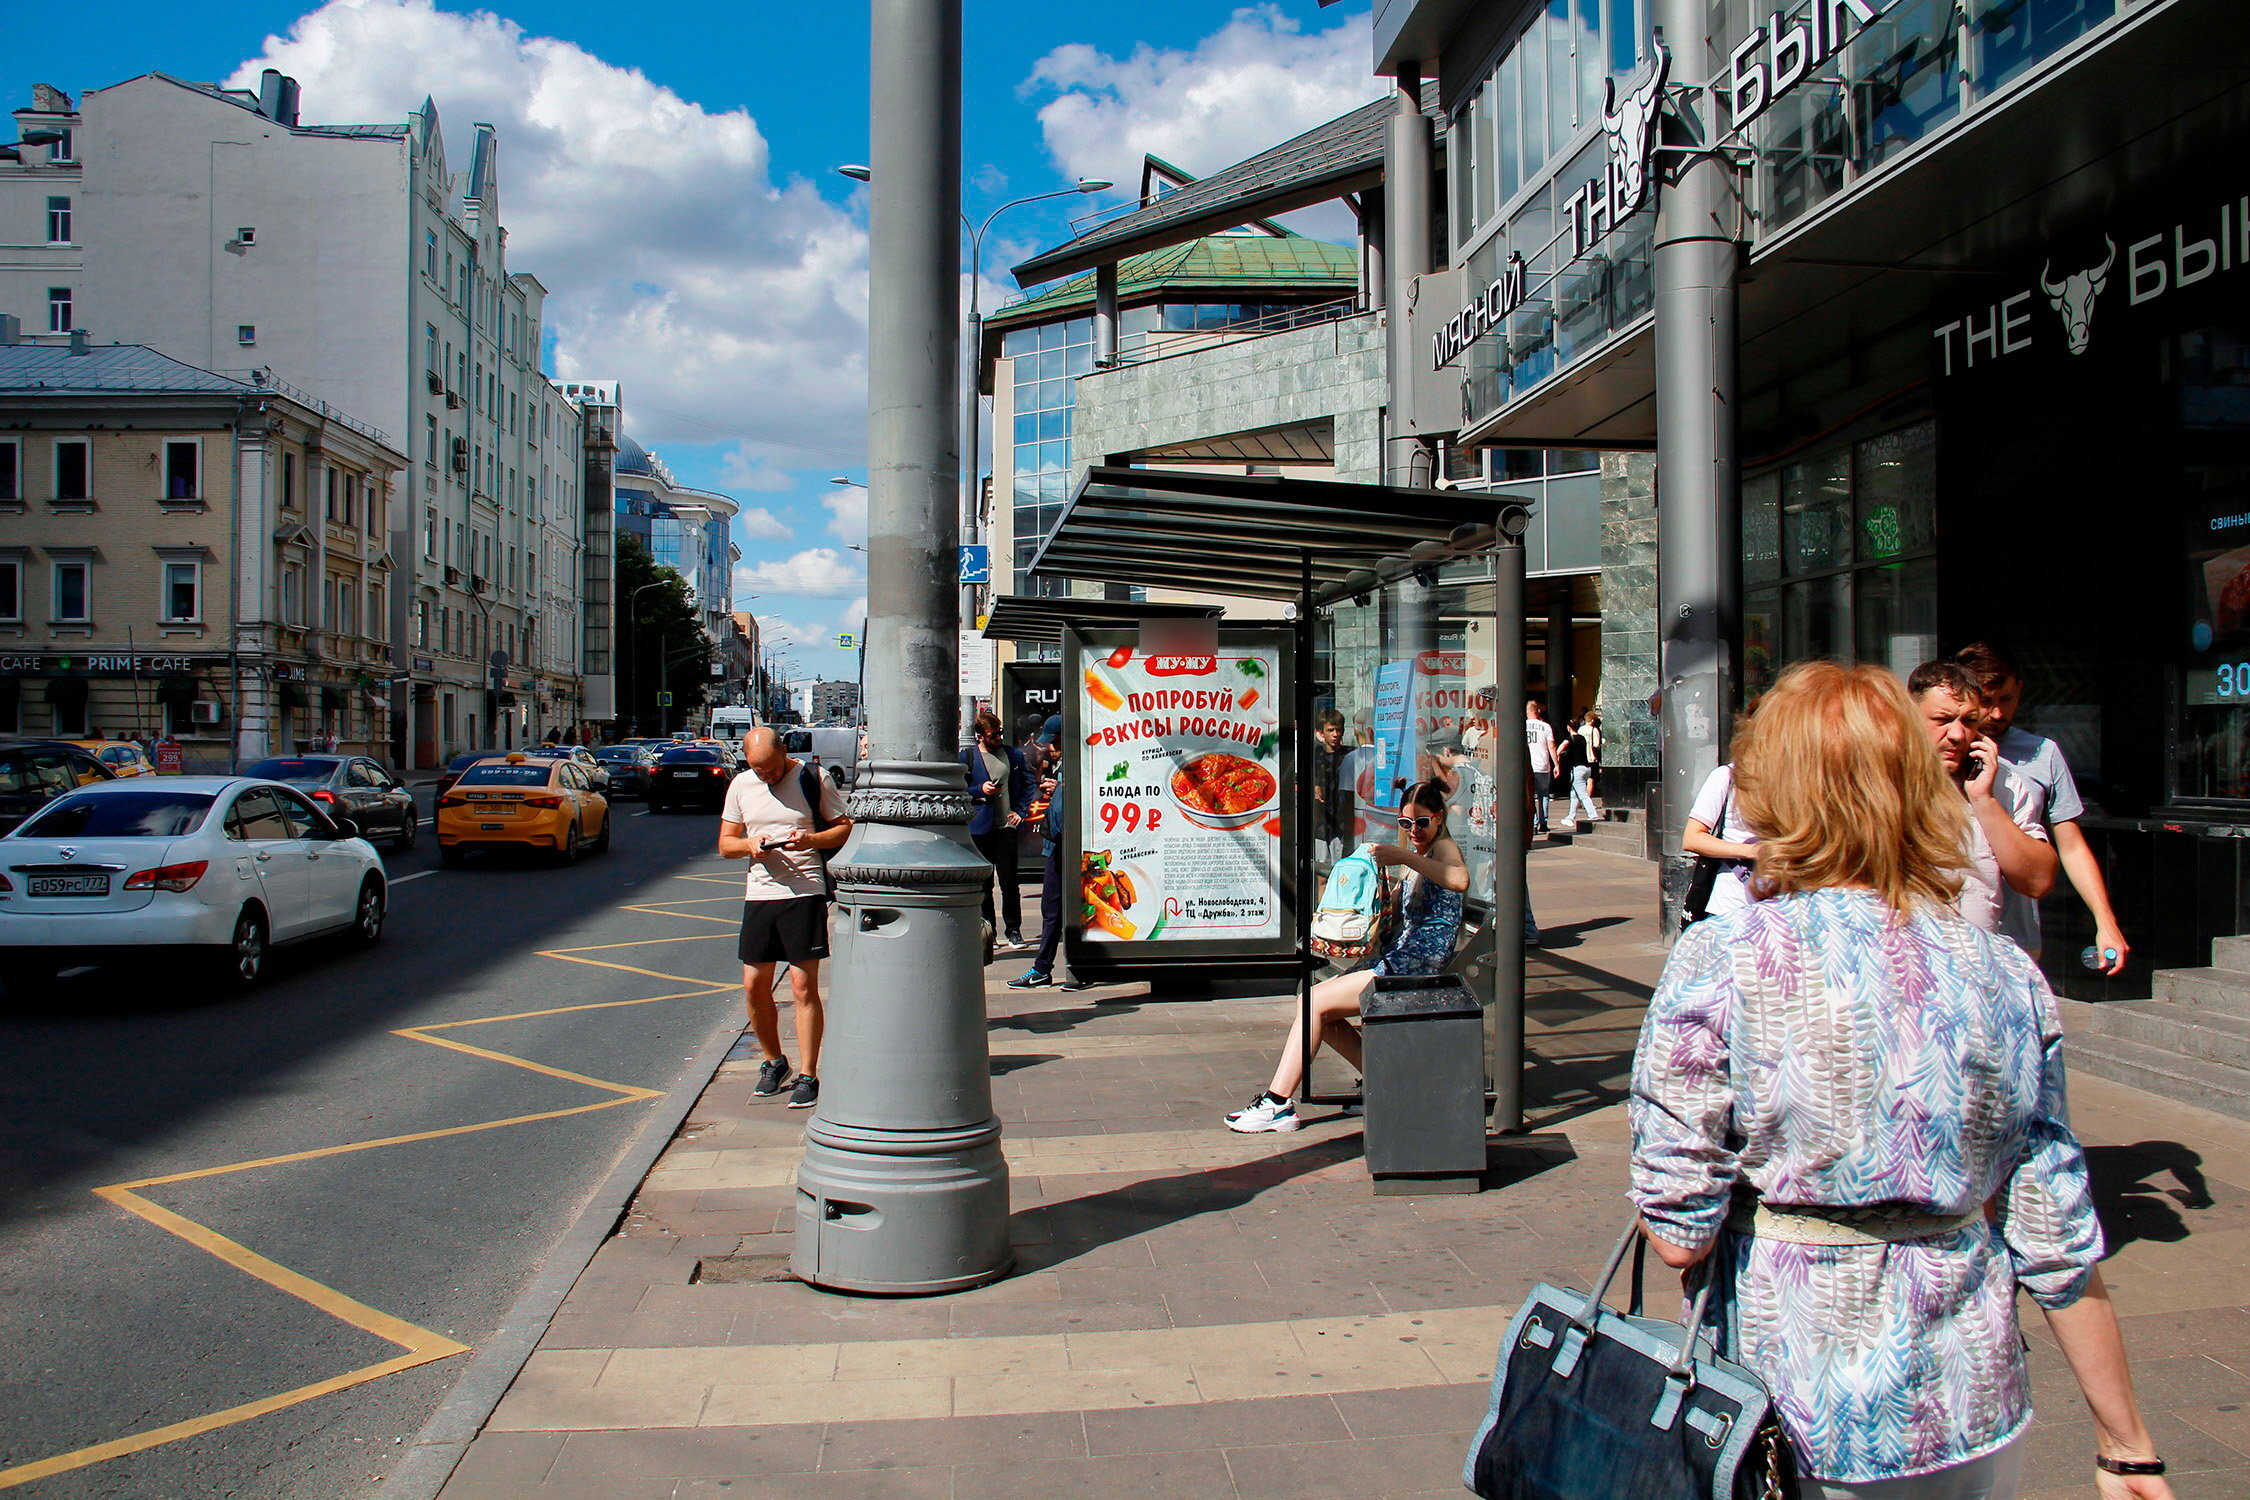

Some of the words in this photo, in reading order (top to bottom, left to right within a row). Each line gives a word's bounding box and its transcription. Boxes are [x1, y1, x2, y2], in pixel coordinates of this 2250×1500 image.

[1432, 251, 1526, 371] МЯСНОЙ
[1934, 290, 2032, 377] THE
[1, 657, 41, 670] CAFE
[88, 657, 142, 671] PRIME
[152, 657, 191, 670] CAFE
[1026, 689, 1062, 704] RU
[1128, 687, 1234, 713] ПОПРОБУЙ
[1102, 717, 1172, 747] ВКУСЫ
[1180, 716, 1262, 747] РОССИИ
[1142, 747, 1163, 756] КУРИЦА
[1099, 786, 1141, 798] БЛЮДА
[1146, 785, 1161, 796] ПО
[1100, 802, 1141, 833] 99
[1120, 847, 1136, 855] САЛАТ
[1185, 899, 1196, 908] ул.
[1198, 897, 1257, 907] Новослободская,
[1258, 896, 1266, 906] 4,
[1185, 909, 1196, 919] ТЦ
[1198, 908, 1238, 919] «Дружба»,
[1240, 908, 1246, 917] 2
[1247, 909, 1265, 917] этаж
